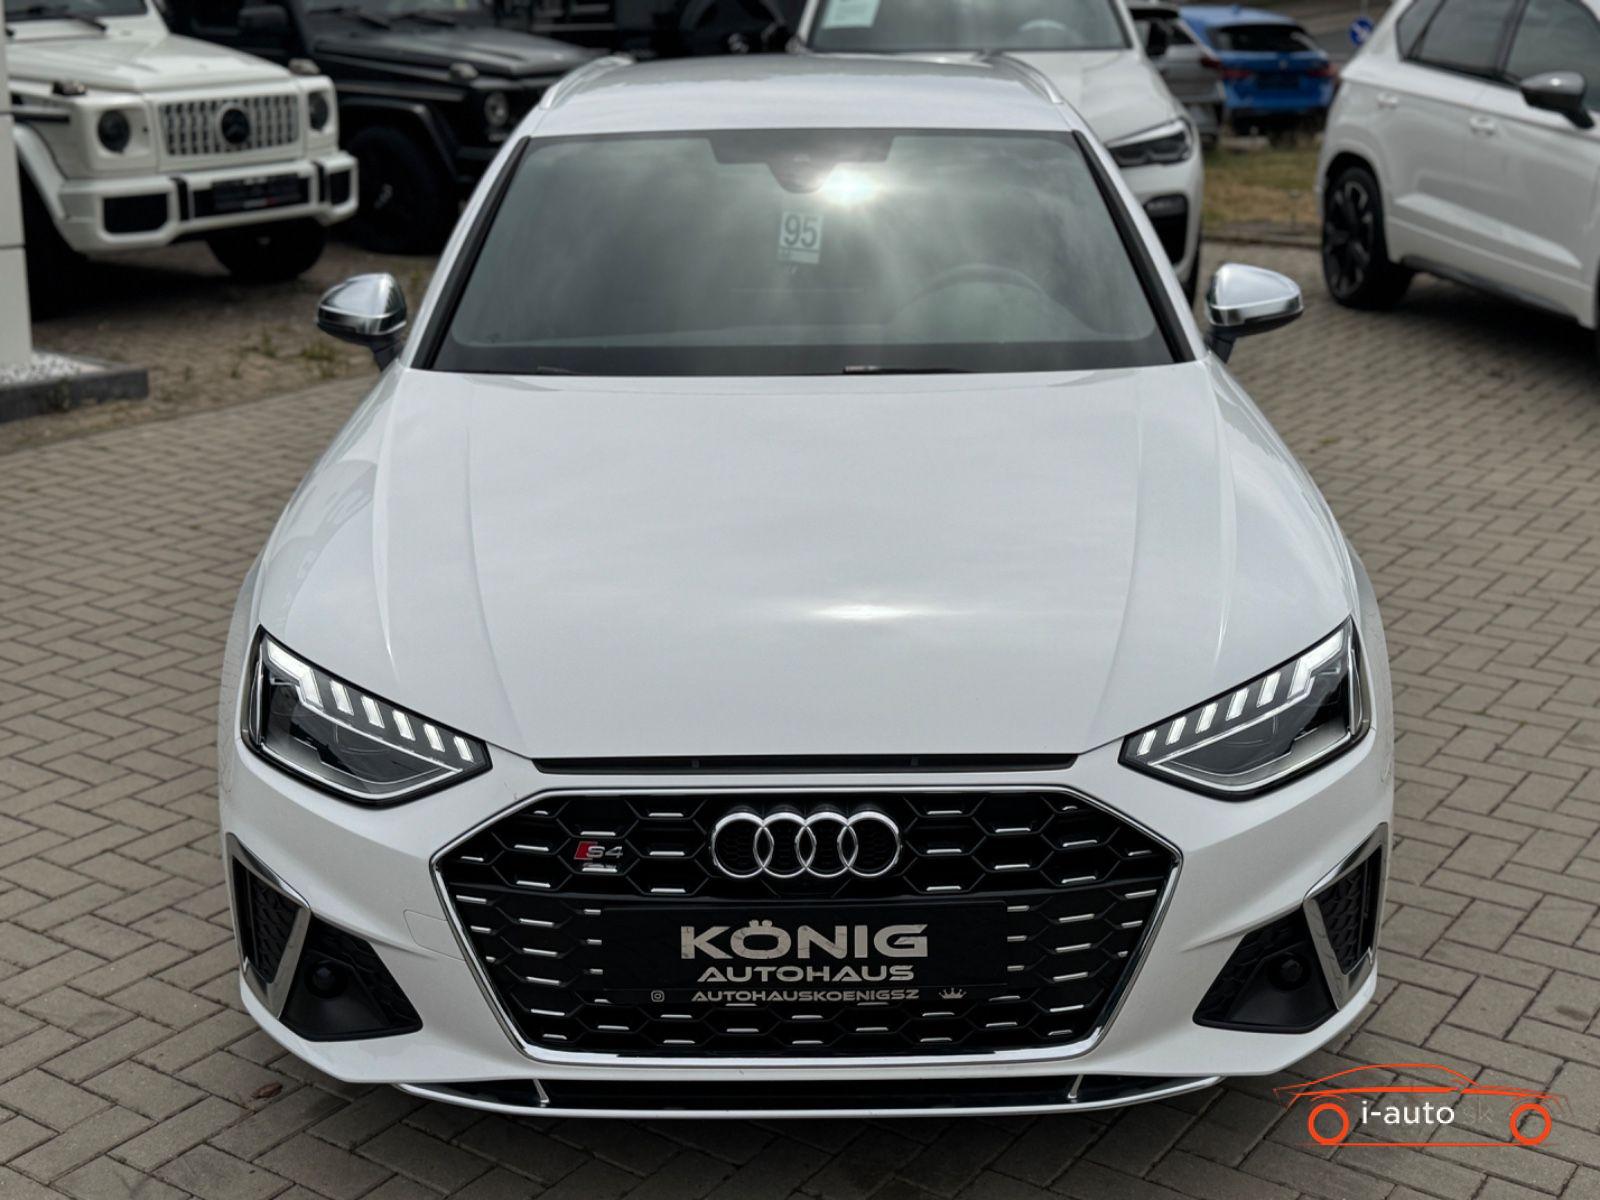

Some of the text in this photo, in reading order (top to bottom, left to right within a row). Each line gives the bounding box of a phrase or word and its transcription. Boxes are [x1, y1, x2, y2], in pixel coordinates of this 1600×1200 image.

[784, 214, 818, 248] 95
[586, 845, 624, 859] S4
[680, 919, 929, 960] KÖNIG
[697, 965, 914, 983] AUTOHAUS
[691, 989, 920, 1002] AUTOHAUSKOENIGSZ
